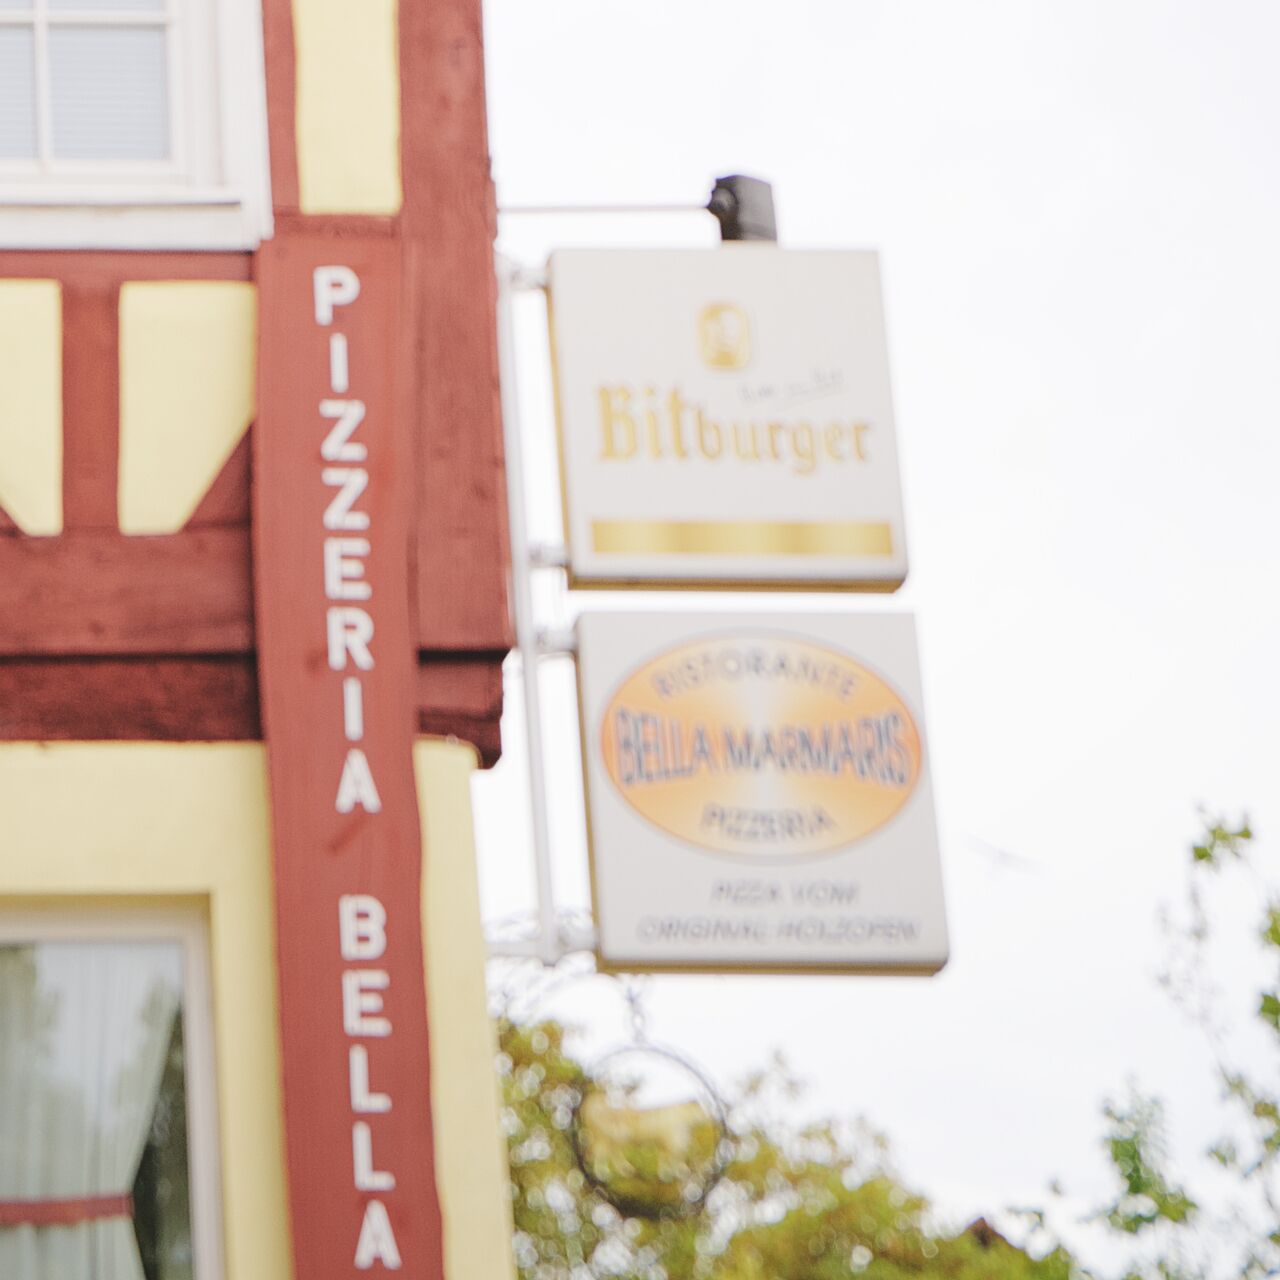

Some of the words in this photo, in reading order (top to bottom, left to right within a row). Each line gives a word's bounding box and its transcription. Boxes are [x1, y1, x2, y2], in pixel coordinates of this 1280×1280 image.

[597, 385, 873, 476] Bitburger
[313, 265, 382, 813] PIZZERIA
[652, 646, 861, 700] RISTORANTE
[615, 706, 714, 788] BELLA
[722, 710, 910, 789] MARMARIS
[700, 804, 837, 842] PIZZERIA
[338, 894, 402, 1271] BELLA
